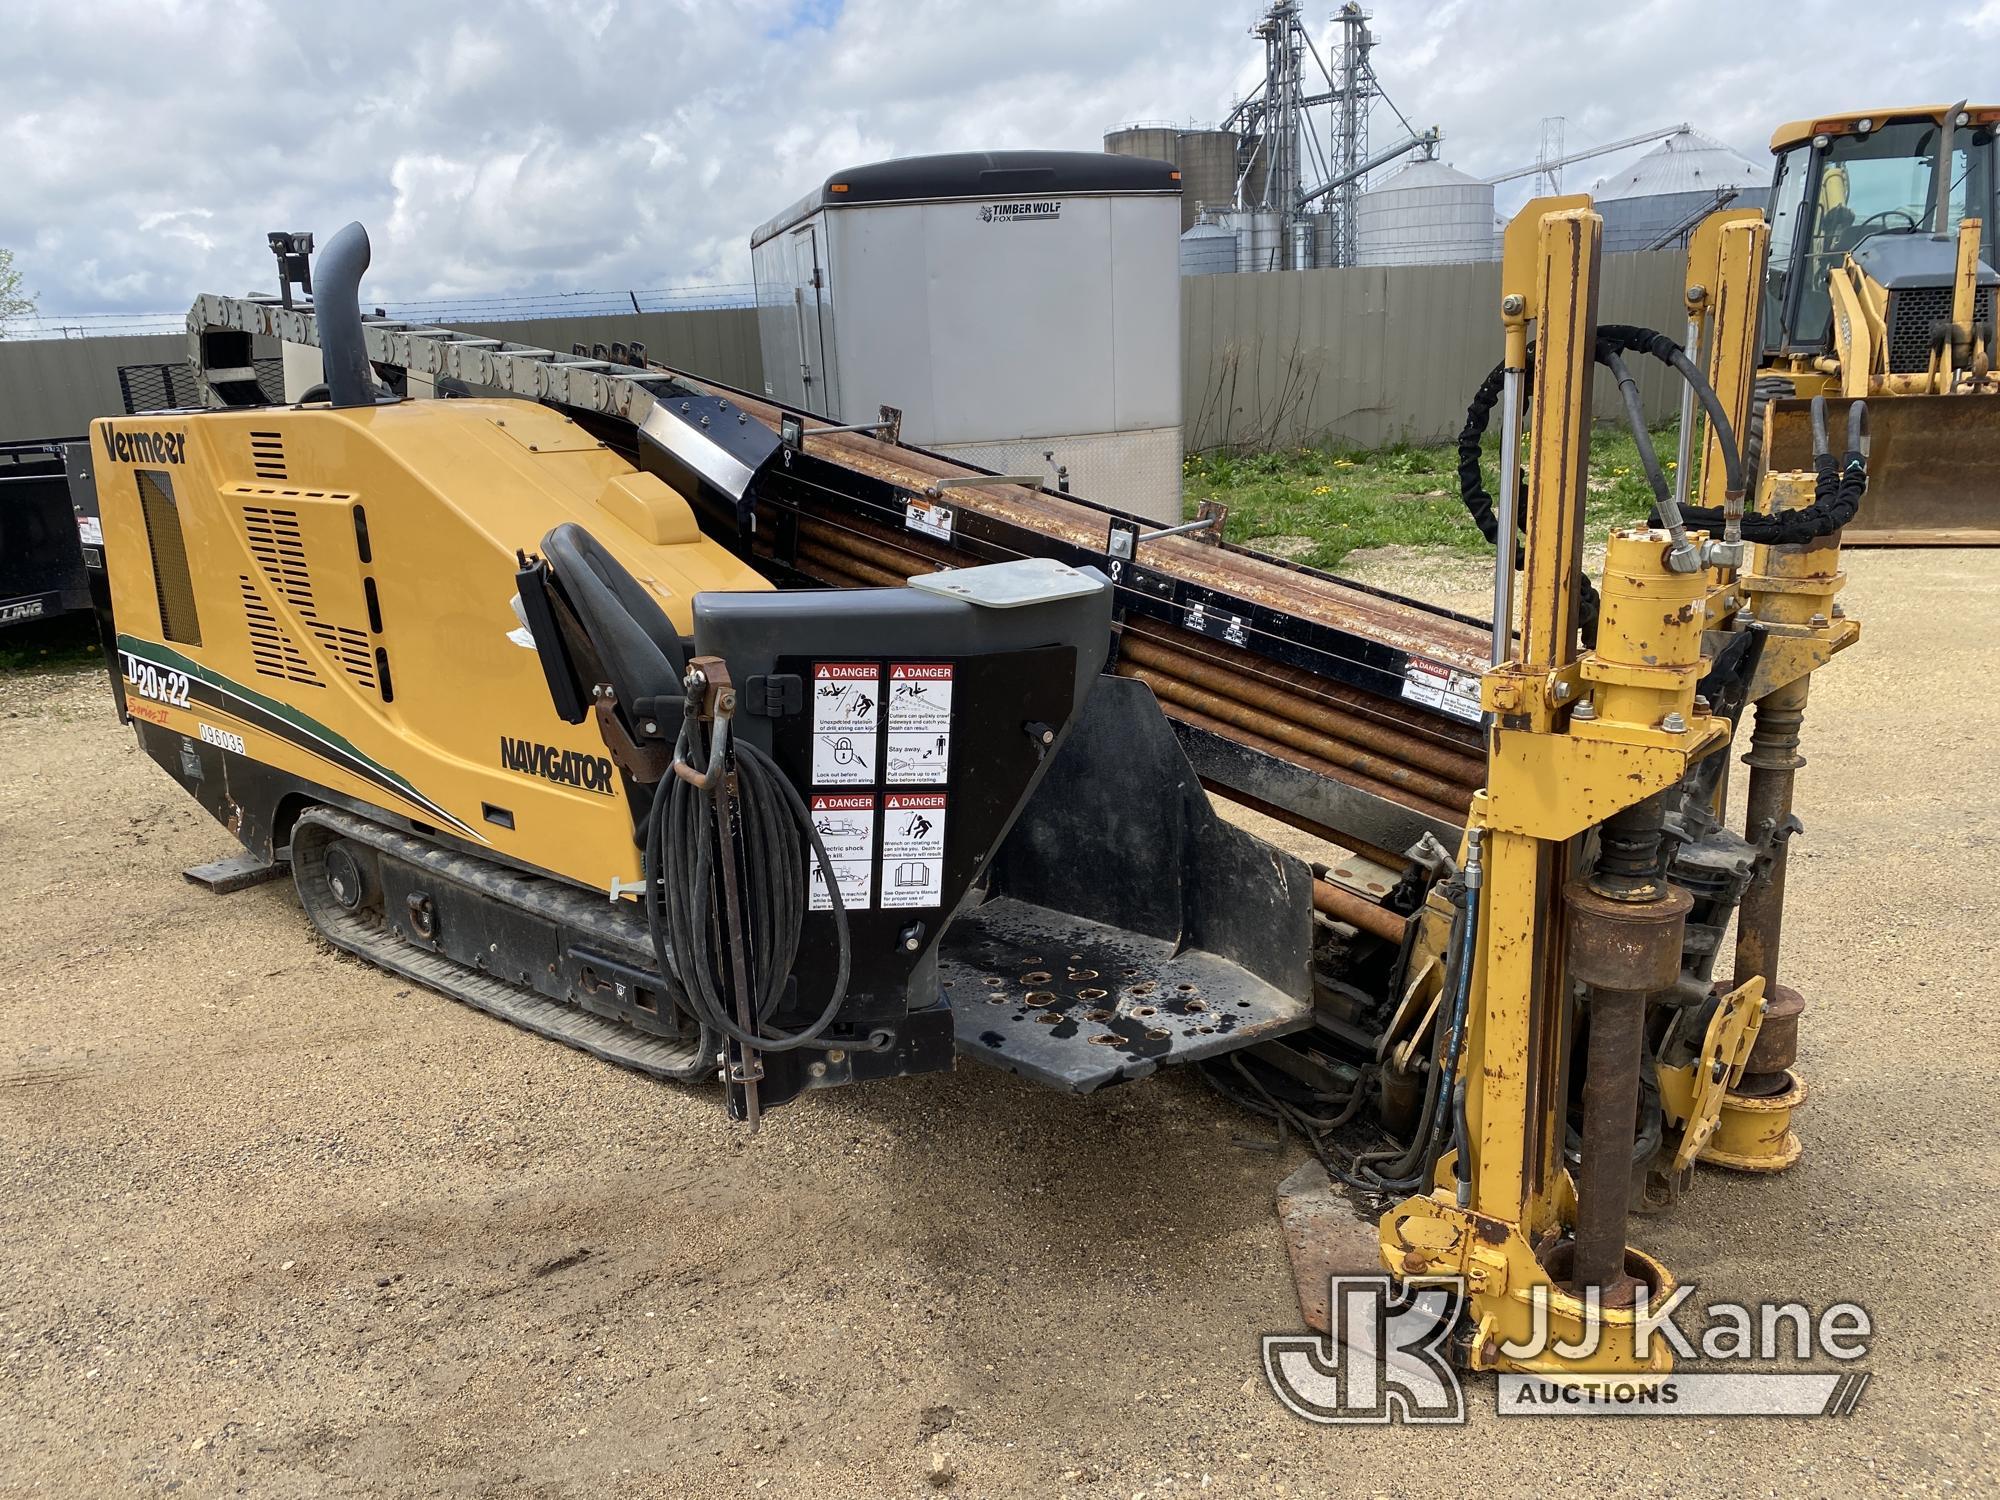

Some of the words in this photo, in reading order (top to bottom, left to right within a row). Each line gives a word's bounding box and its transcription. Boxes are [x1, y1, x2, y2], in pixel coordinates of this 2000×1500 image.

[993, 203, 1031, 215] TIMBER
[1033, 202, 1061, 213] WOLF
[100, 421, 186, 464] Vermeer
[1, 602, 43, 621] LING
[832, 667, 877, 677] DANGER
[907, 668, 951, 677] DANGER
[1419, 661, 1448, 676] DANGER
[128, 655, 192, 709] D20x22
[200, 724, 244, 754] 096035
[500, 735, 614, 794] NAVIGATOR
[829, 798, 872, 807] DANGER
[902, 797, 944, 806] DANGER
